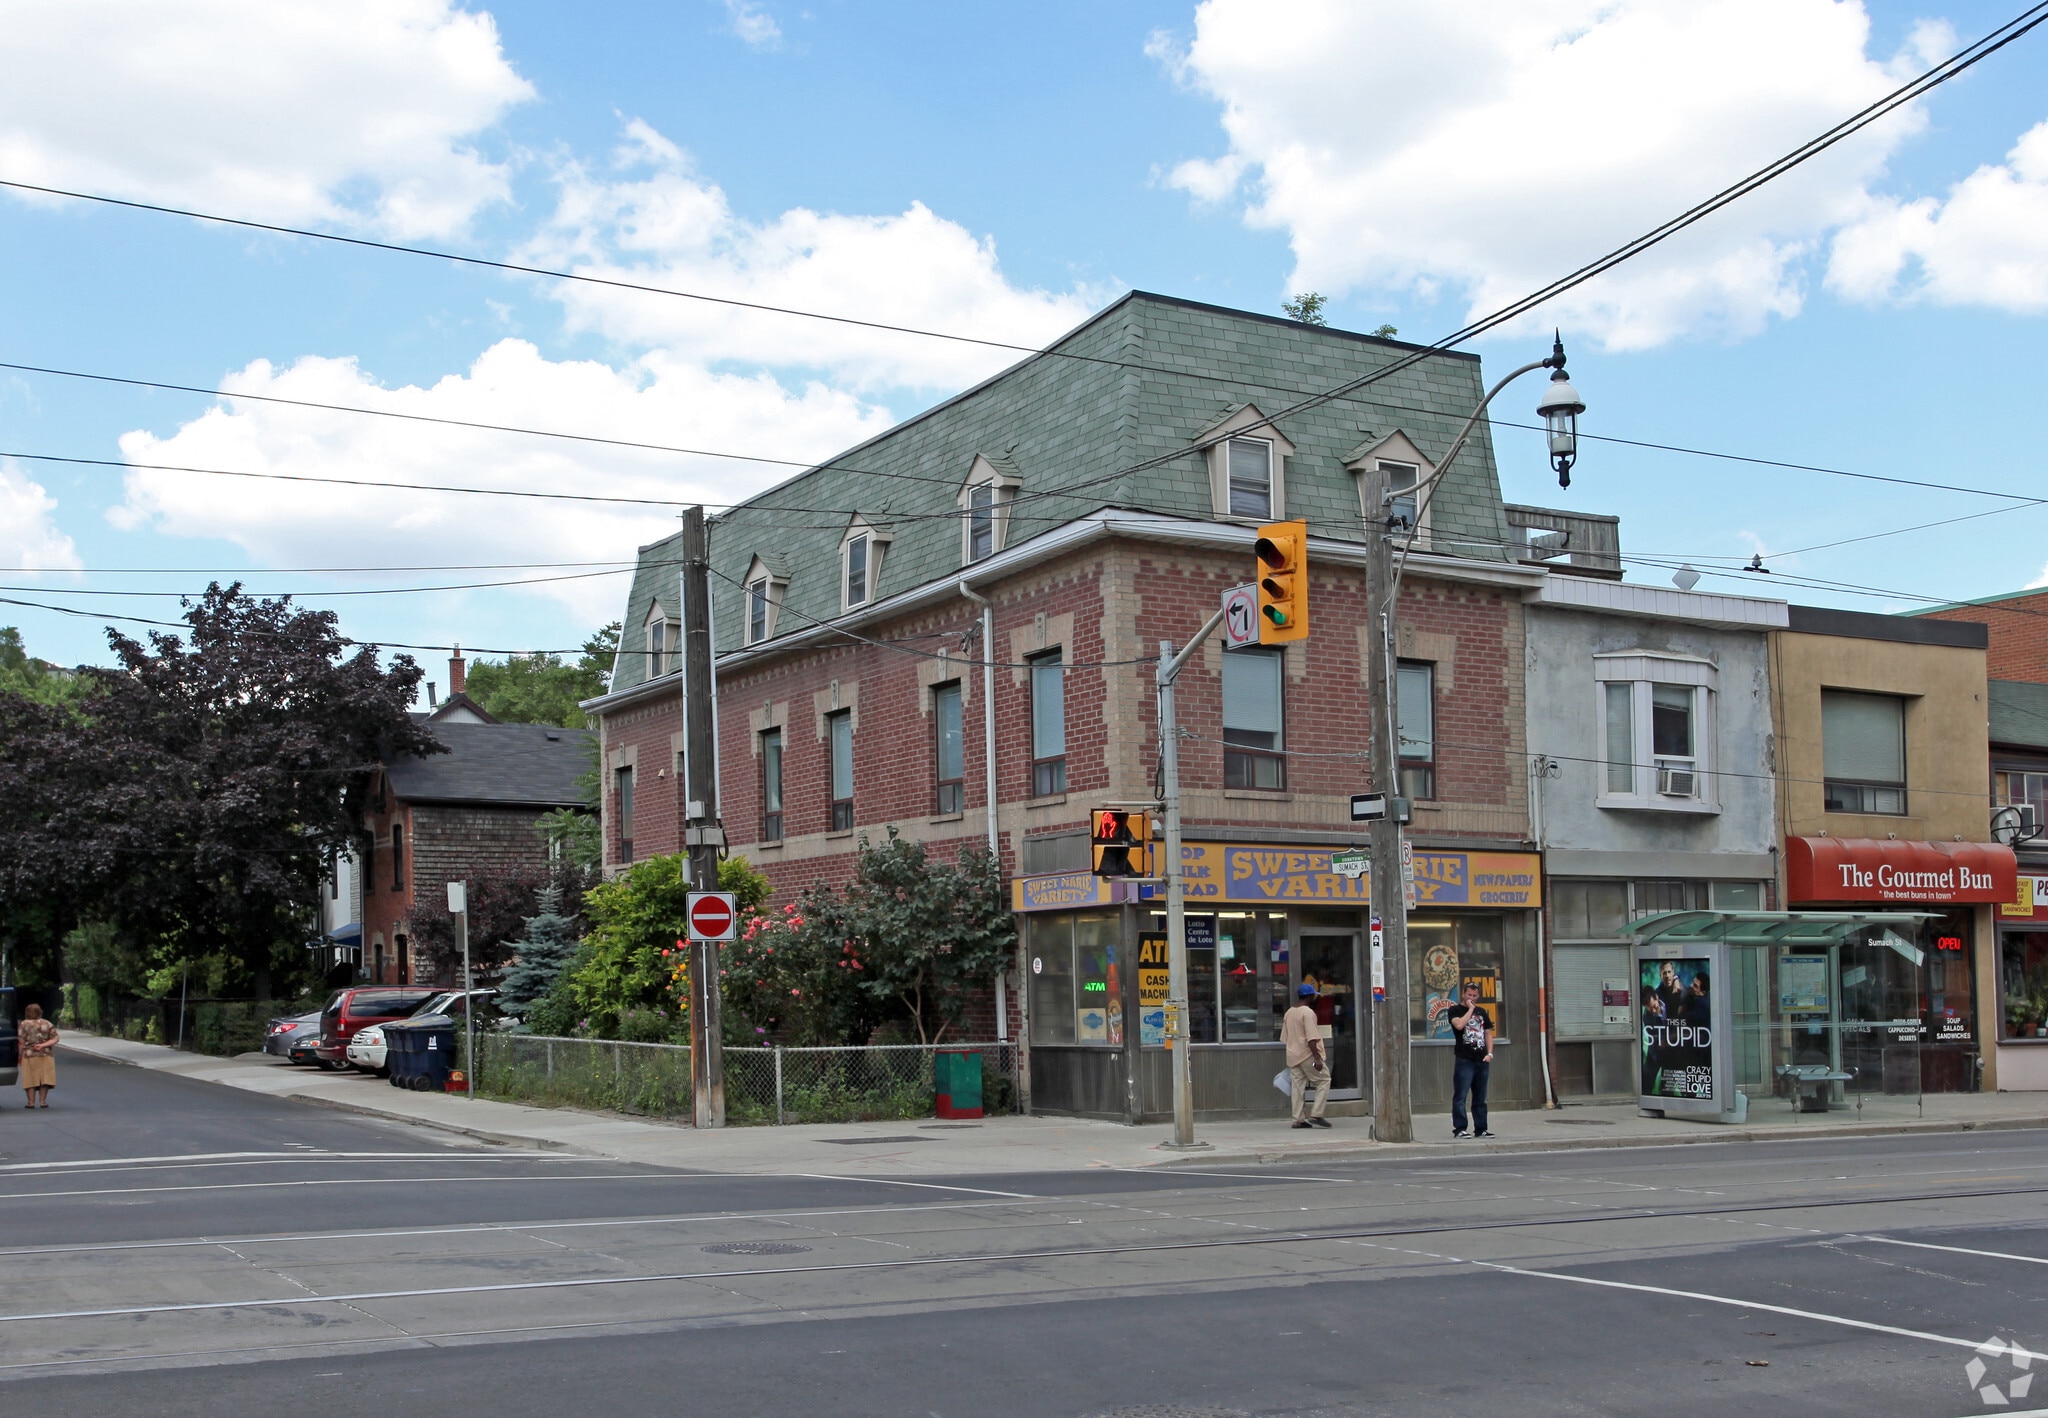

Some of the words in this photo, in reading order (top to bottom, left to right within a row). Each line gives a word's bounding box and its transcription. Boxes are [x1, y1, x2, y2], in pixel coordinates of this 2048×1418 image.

[1181, 847, 1206, 860] OP
[1231, 852, 1331, 880] SWEE
[1412, 856, 1462, 886] RIE
[1338, 863, 1359, 871] SUMACH
[1474, 874, 1534, 887] NEWSPAPERS
[1838, 864, 1873, 887] The
[1877, 864, 1954, 889] Gourmet
[1958, 867, 1993, 889] Bun
[1027, 879, 1058, 897] SWEET
[1060, 875, 1093, 893] MARIE
[1155, 883, 1219, 896] BEAD
[1257, 873, 1441, 899] VARIY
[1033, 889, 1088, 904] VARIETY
[1480, 891, 1529, 903] GROCERIES
[1883, 891, 1895, 899] the
[1895, 891, 1910, 899] best
[1911, 891, 1927, 899] buns
[1928, 892, 1934, 900] in
[1936, 892, 1952, 900] town
[1188, 928, 1209, 936] Centre
[1868, 938, 1894, 947] Sumach
[1895, 938, 1902, 946] St
[1937, 937, 1962, 950] OPEN
[1084, 982, 1106, 992] ATM
[1140, 989, 1169, 1000] MACHI
[1428, 1000, 1456, 1020] DRUMSTIC
[1643, 1025, 1711, 1048] STUPID
[1936, 1032, 1971, 1040] SANDWICHES
[1686, 1065, 1711, 1075] CRAZY
[1686, 1074, 1712, 1084] STUPID
[1686, 1082, 1711, 1094] LOVE
